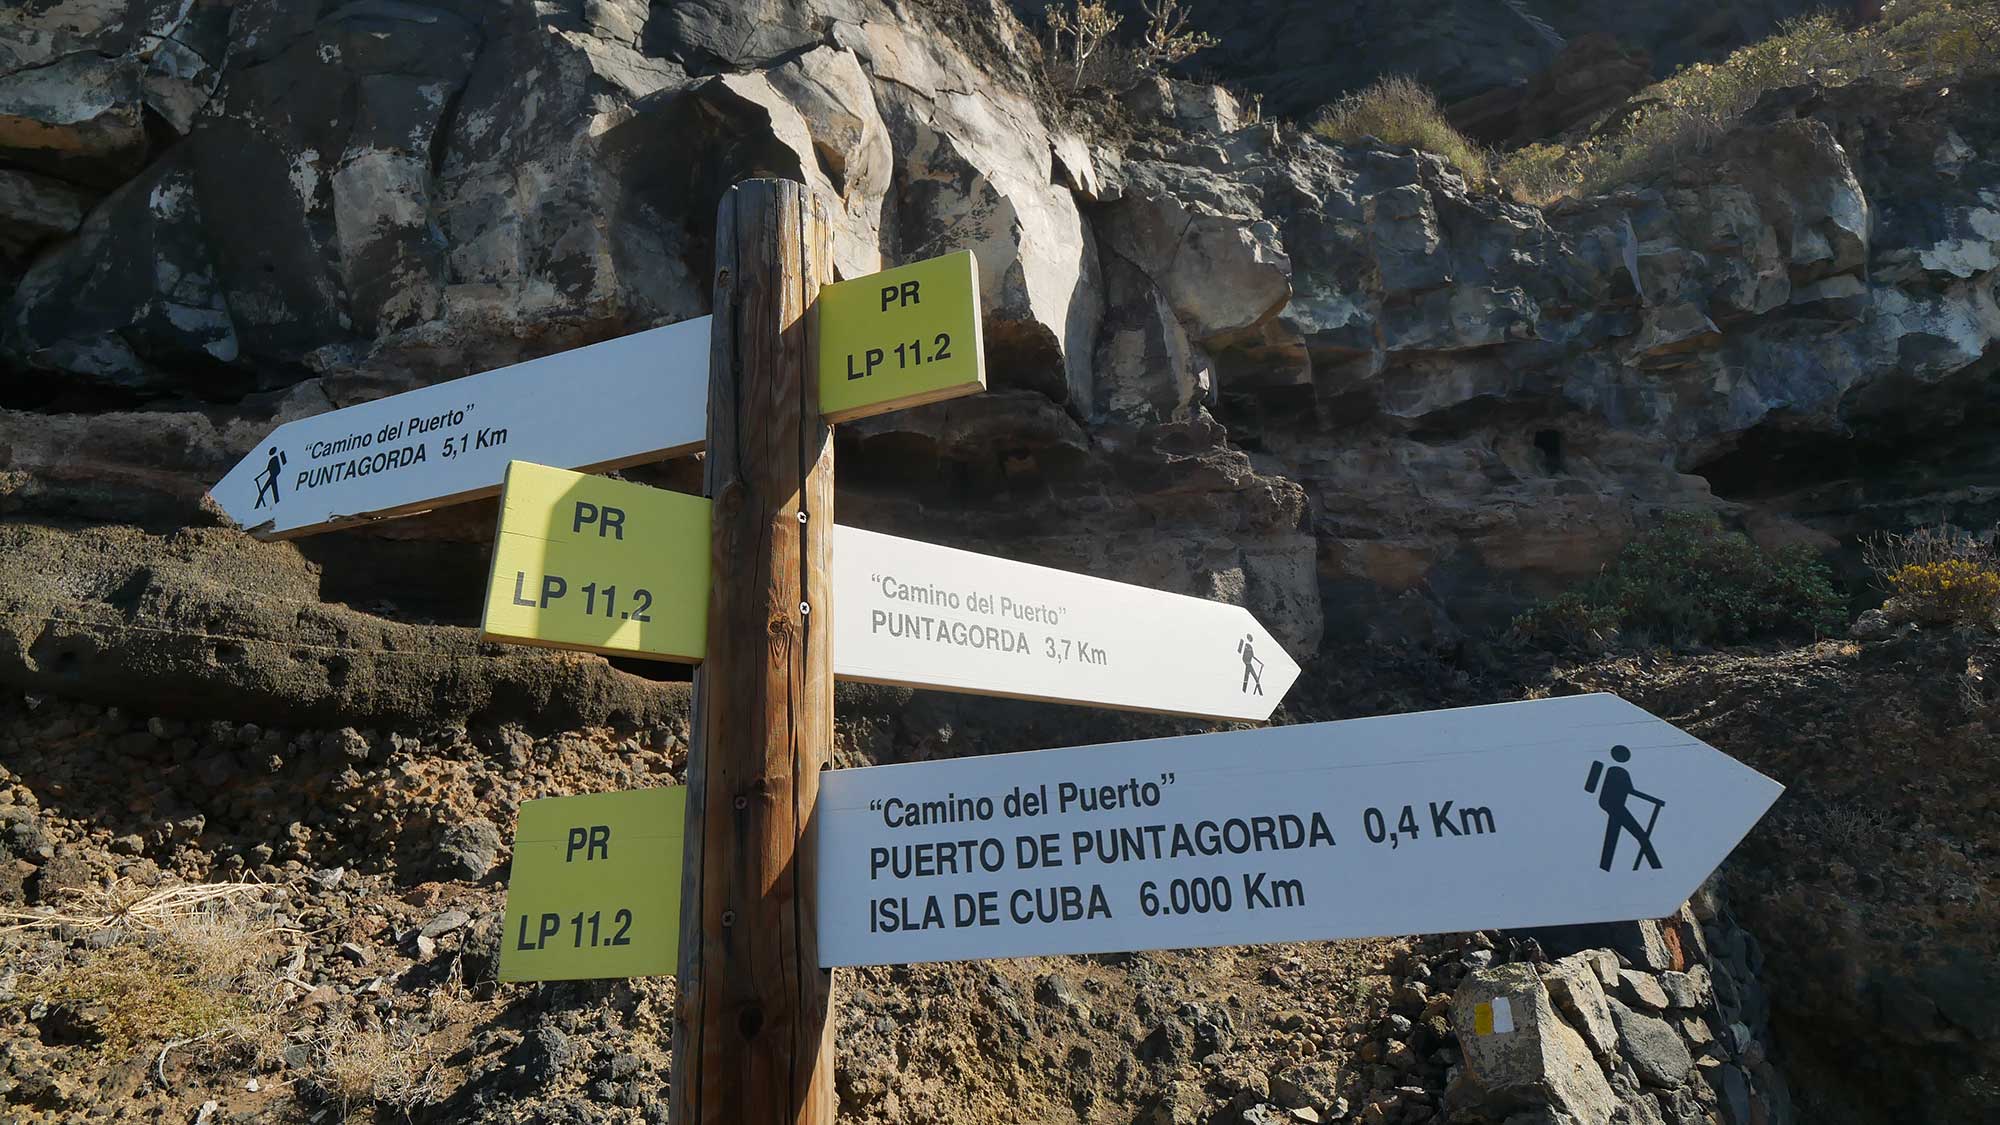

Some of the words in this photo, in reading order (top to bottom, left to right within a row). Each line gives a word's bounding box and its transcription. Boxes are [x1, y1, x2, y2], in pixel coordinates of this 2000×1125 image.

[881, 281, 920, 312] PR
[847, 348, 884, 380] LP
[894, 333, 951, 368] 11.2
[377, 421, 403, 443] del
[296, 443, 426, 491] PUNTAGORDA
[442, 433, 468, 460] 5,1
[476, 428, 507, 449] Km
[573, 501, 625, 540] PR
[513, 571, 567, 609] LP
[581, 583, 652, 622] 11.2
[967, 592, 994, 615] del
[871, 609, 1030, 655] PUNTAGORDA
[1045, 637, 1071, 664] 3,7
[1078, 641, 1107, 665] Km
[1004, 784, 1048, 818] del
[566, 825, 610, 862] PR
[871, 838, 1004, 880] PUERTO
[1016, 833, 1063, 869] DE
[1072, 812, 1336, 865] PUNTAGORDA
[1364, 805, 1419, 849] 0,4
[1429, 801, 1496, 837] Km
[871, 896, 945, 932] ISLA
[954, 891, 1000, 928] DE
[1010, 884, 1112, 924] CUBA
[1140, 876, 1232, 916] 6.000
[1243, 872, 1305, 909] Km
[517, 913, 560, 951] LP
[571, 909, 632, 948] 11.2
